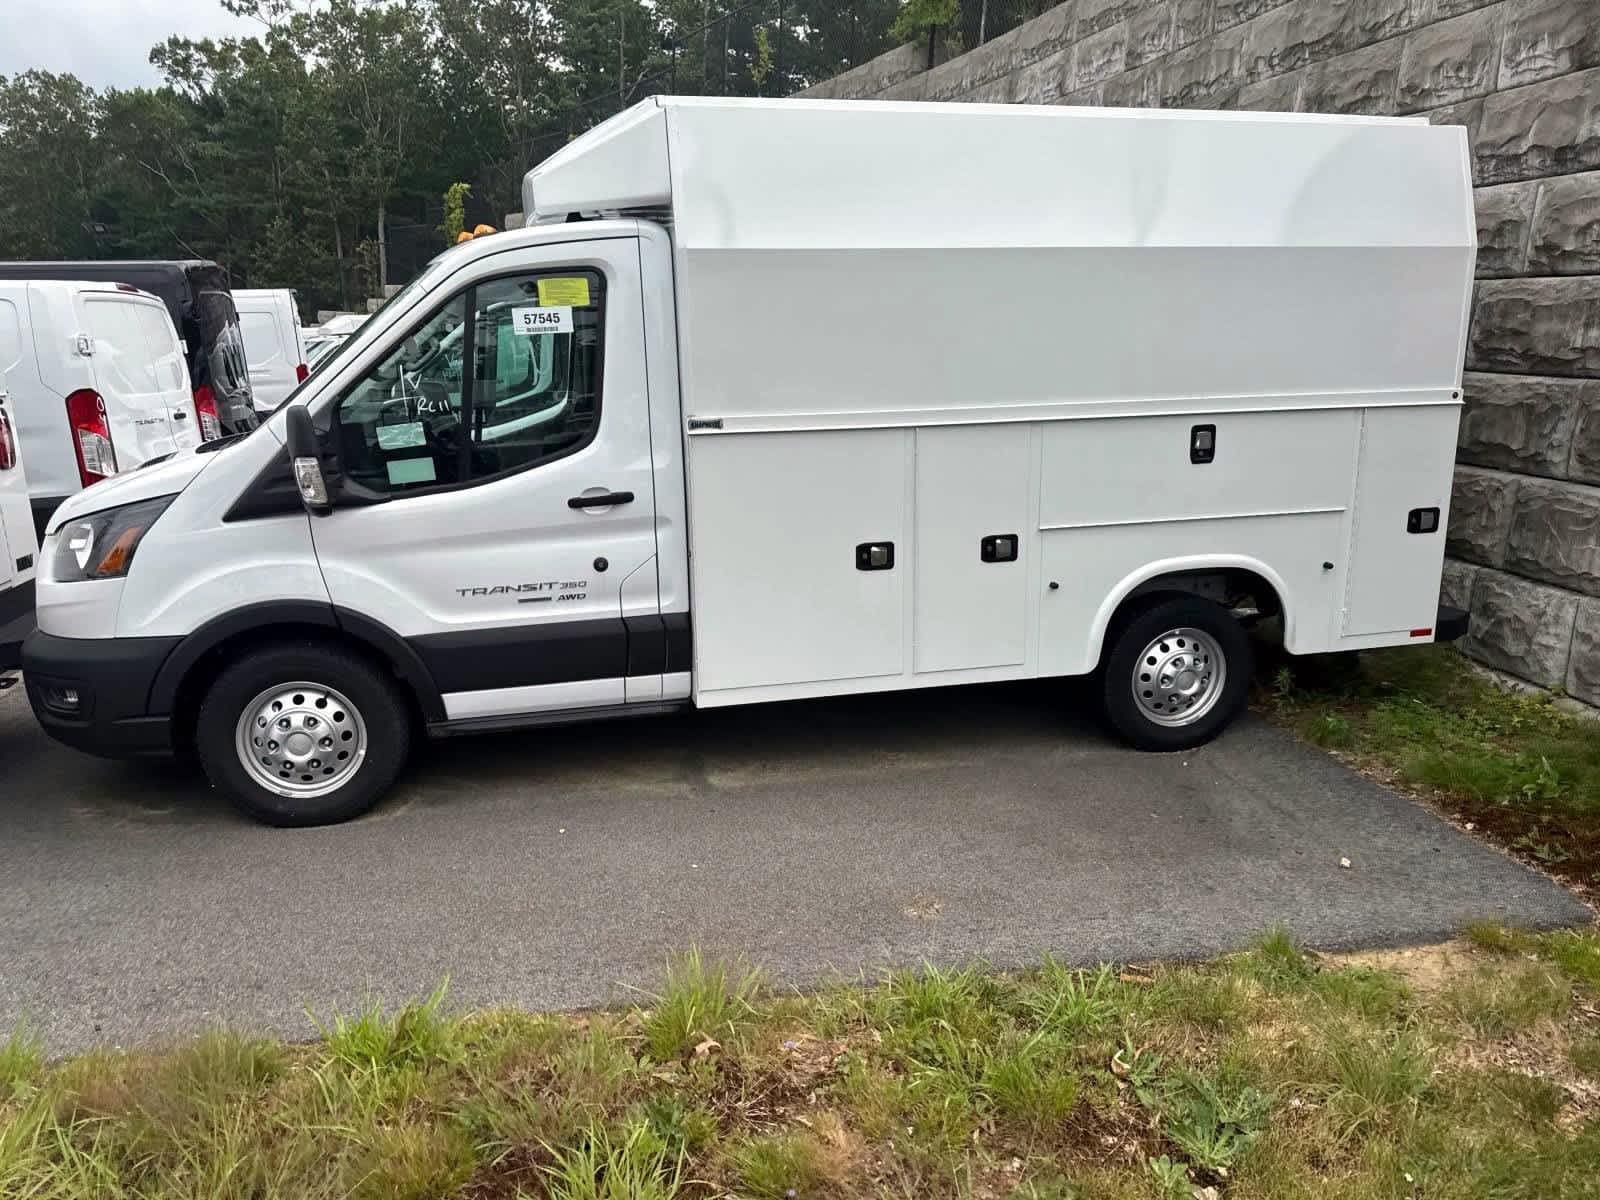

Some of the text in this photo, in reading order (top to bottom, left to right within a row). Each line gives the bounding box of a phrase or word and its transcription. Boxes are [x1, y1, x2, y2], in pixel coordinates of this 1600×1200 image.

[523, 312, 561, 325] 57545
[455, 580, 587, 597] TRANSIT 350
[556, 592, 587, 601] AWD
